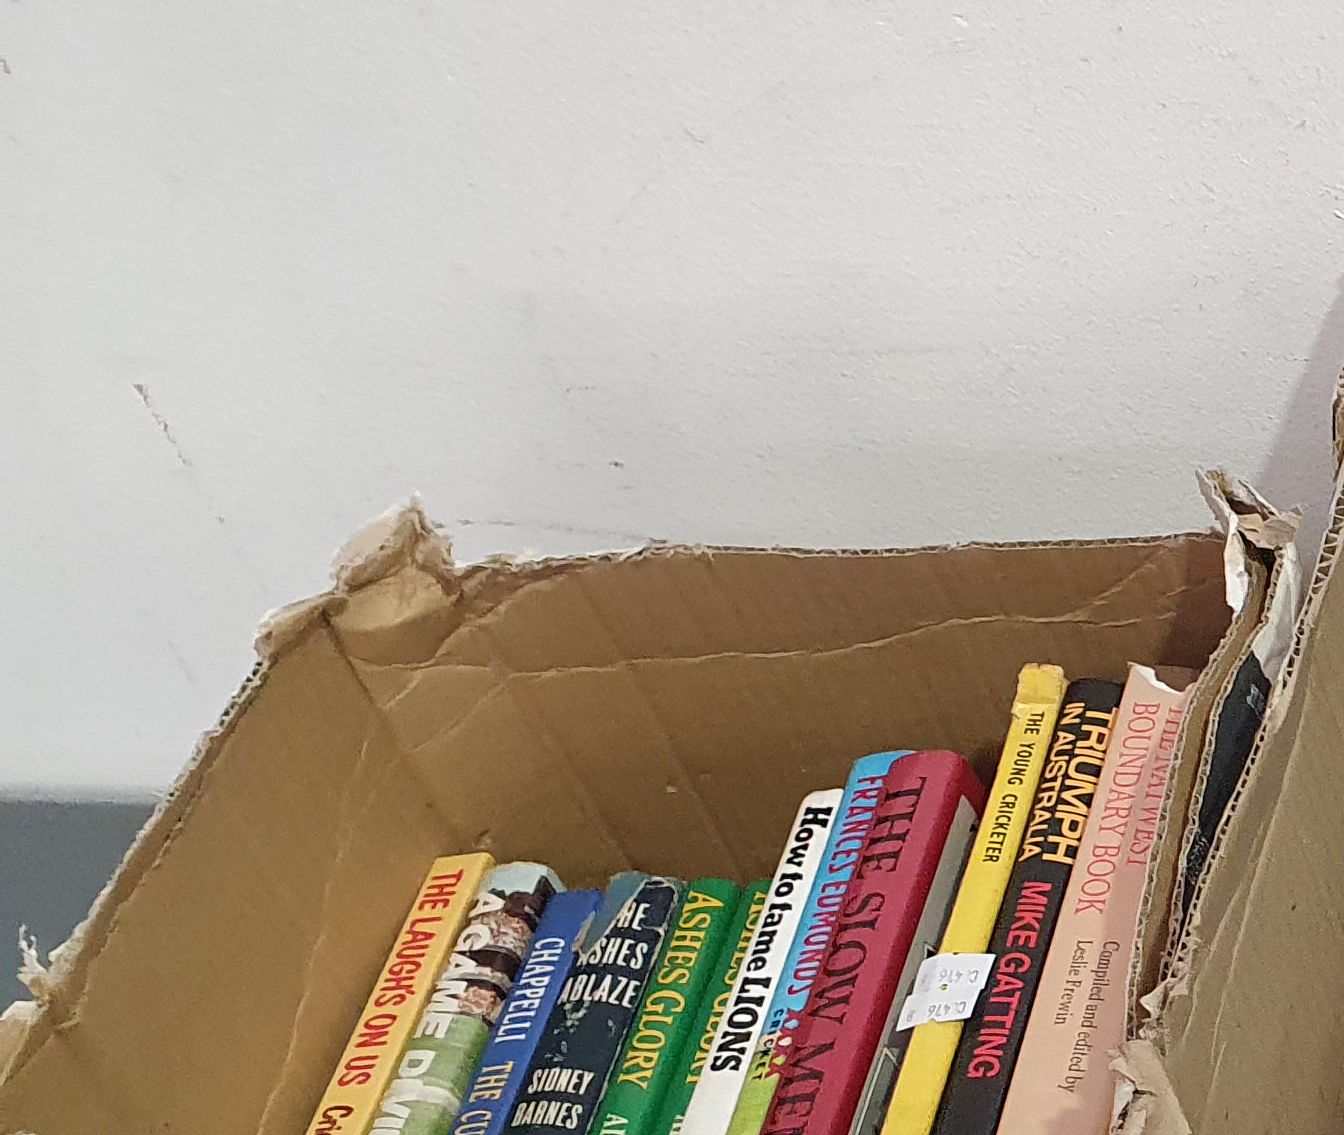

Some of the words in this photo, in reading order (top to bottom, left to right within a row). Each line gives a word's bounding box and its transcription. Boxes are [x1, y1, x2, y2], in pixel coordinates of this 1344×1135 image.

[1022, 711, 1045, 736] THE
[1060, 702, 1086, 726] IN
[1004, 742, 1036, 786] YOUNG
[1041, 706, 1118, 866] TRIUMPH
[1100, 702, 1162, 836] BOUNDARY
[1018, 730, 1072, 862] AUSTRALIA
[788, 806, 834, 868] How
[855, 776, 928, 882] THE
[982, 793, 1018, 864] CRICKETER
[418, 868, 464, 915] THE
[467, 892, 505, 917] A
[773, 871, 804, 897] to
[1074, 844, 1120, 915] BOOK
[657, 890, 726, 986] ASHES
[745, 900, 793, 972] tame
[1005, 880, 1053, 949] MIKE
[374, 916, 444, 1008] LAUGH'S
[414, 924, 493, 1039] GAME
[806, 890, 886, 1026] SLOW
[1068, 940, 1093, 976] Leslie
[1088, 940, 1121, 1001] Compiled
[494, 937, 566, 1044] CHAPPELLI
[557, 973, 641, 1008] ABLAZE
[966, 951, 1032, 1080] GATTING
[1054, 979, 1082, 1025] Frewin
[1081, 1004, 1098, 1028] and
[354, 1013, 398, 1048] ON
[618, 989, 686, 1090] GLORY
[709, 975, 772, 1072] LIONS
[750, 1007, 787, 1081] CRICKET
[1067, 1031, 1092, 1072] edited
[337, 1054, 379, 1088] US
[468, 1061, 514, 1103] THE
[527, 1068, 595, 1095] SIDNEY
[1057, 1076, 1084, 1093] by
[510, 1101, 584, 1129] BARNES
